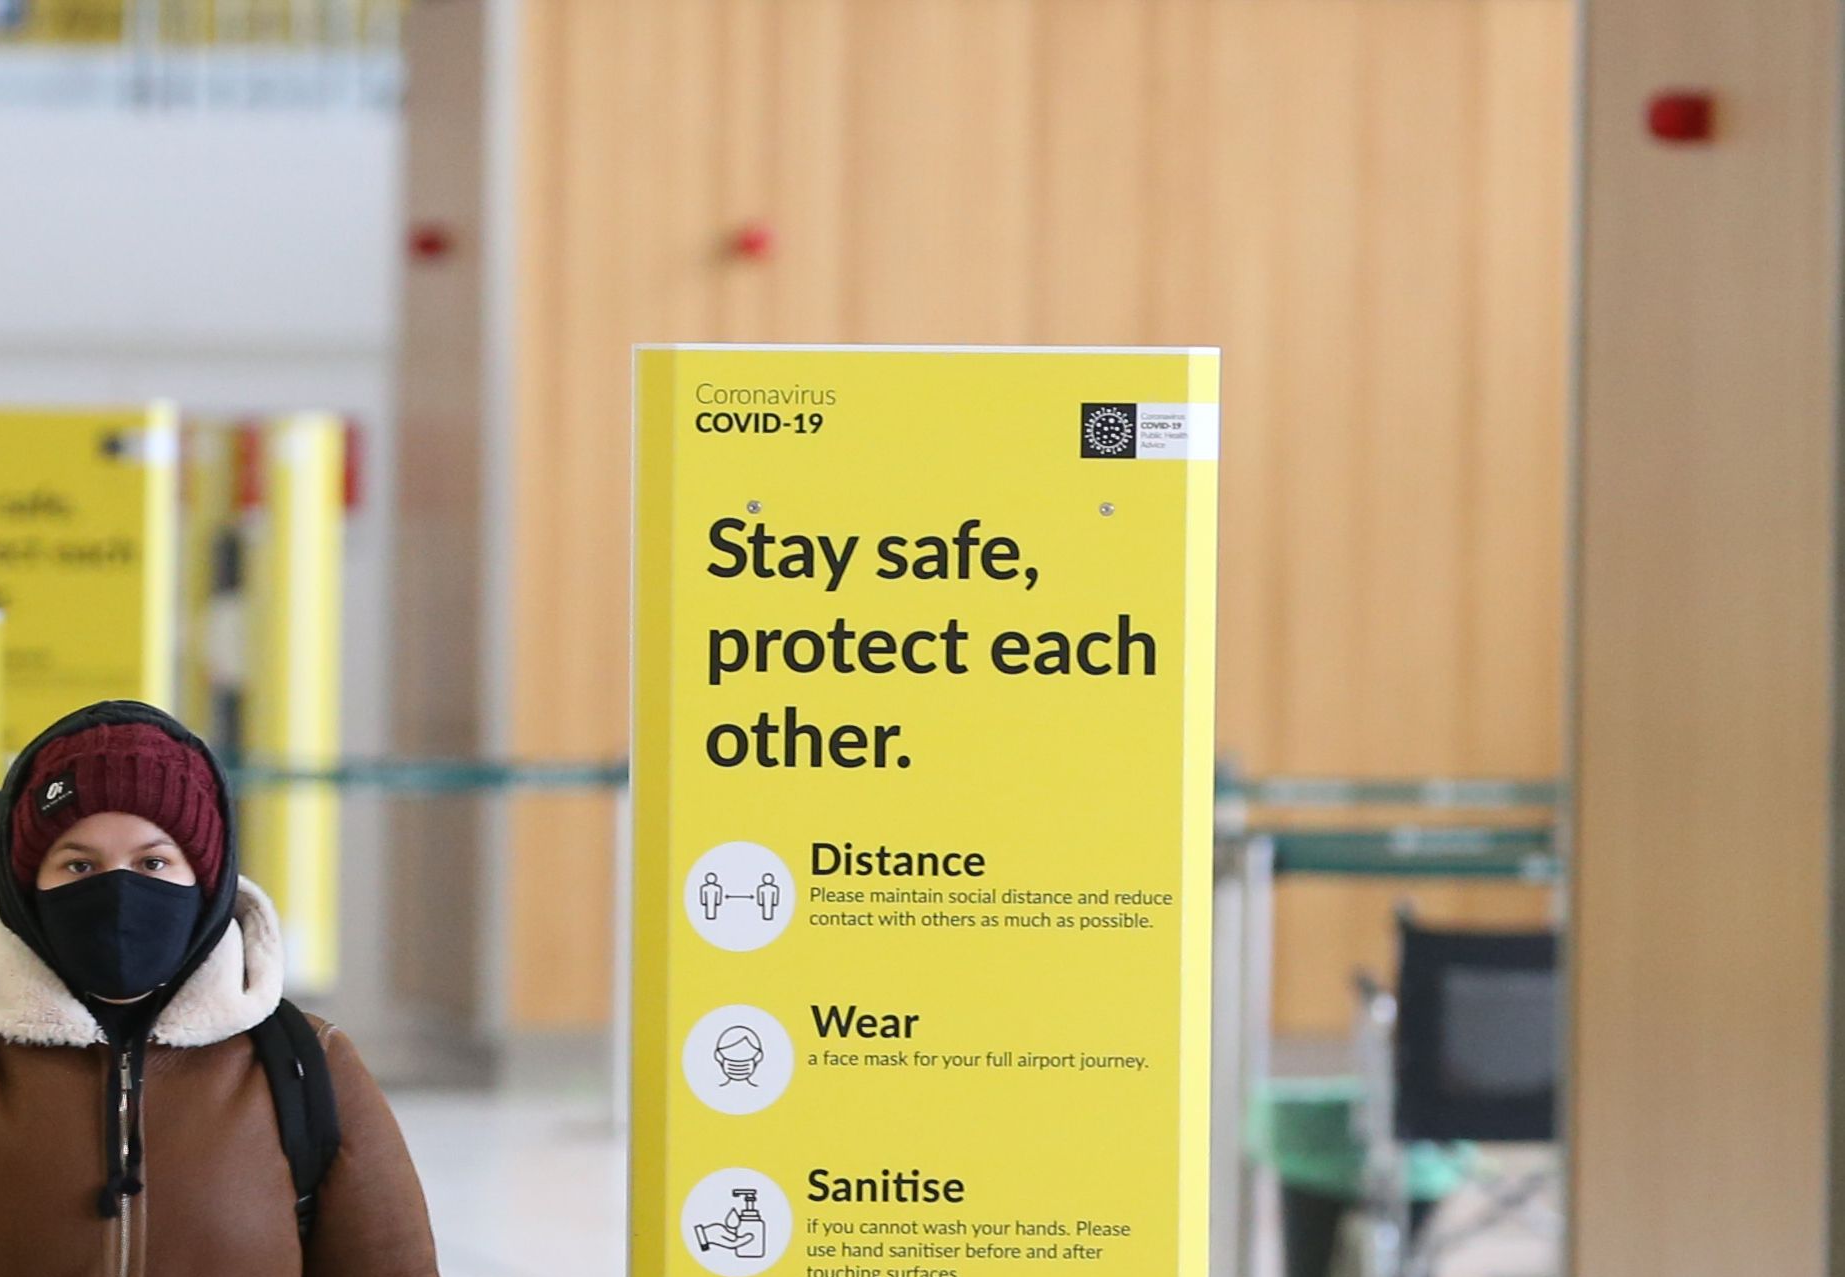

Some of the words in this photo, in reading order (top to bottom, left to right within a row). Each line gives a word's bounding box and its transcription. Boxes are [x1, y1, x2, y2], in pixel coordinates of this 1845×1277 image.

[696, 383, 836, 405] Coronavirus
[696, 412, 823, 433] COVID-19
[707, 518, 859, 591] Stay
[876, 519, 1038, 590] safe,
[709, 618, 968, 685] protect
[991, 614, 1155, 675] each
[706, 706, 910, 768] other.
[812, 843, 985, 876] Distance
[810, 887, 864, 902] Please
[870, 888, 943, 903] maintain
[949, 889, 996, 904] social
[1002, 889, 1072, 904] distance
[1078, 890, 1109, 904] and
[1115, 890, 1173, 905] reduce
[810, 912, 874, 926] contact
[878, 911, 915, 926] with
[921, 911, 976, 926] others
[981, 916, 999, 927] as
[1004, 912, 1051, 927] much
[1056, 916, 1074, 927] as
[1080, 913, 1153, 930] possible.
[811, 1005, 919, 1038] Wear
[808, 1054, 817, 1065] a
[823, 1050, 859, 1066] face
[865, 1051, 908, 1066] mask
[914, 1051, 938, 1066] for
[942, 1055, 981, 1069] your
[986, 1052, 1012, 1067] full
[1018, 1052, 1075, 1070] airport
[1079, 1052, 1149, 1071] journey.
[808, 1169, 964, 1203] Sanitise
[807, 1218, 819, 1233] if
[822, 1223, 854, 1237] you
[859, 1221, 918, 1234] cannot
[923, 1220, 967, 1235] wash
[971, 1224, 1011, 1238] your
[1016, 1220, 1070, 1236] hands.
[1077, 1221, 1131, 1236] Please
[807, 1246, 836, 1257] use
[842, 1242, 883, 1257] hand
[889, 1243, 961, 1258] sanitiser
[966, 1243, 1021, 1258] before
[1026, 1244, 1057, 1259] and
[1063, 1244, 1103, 1259] after
